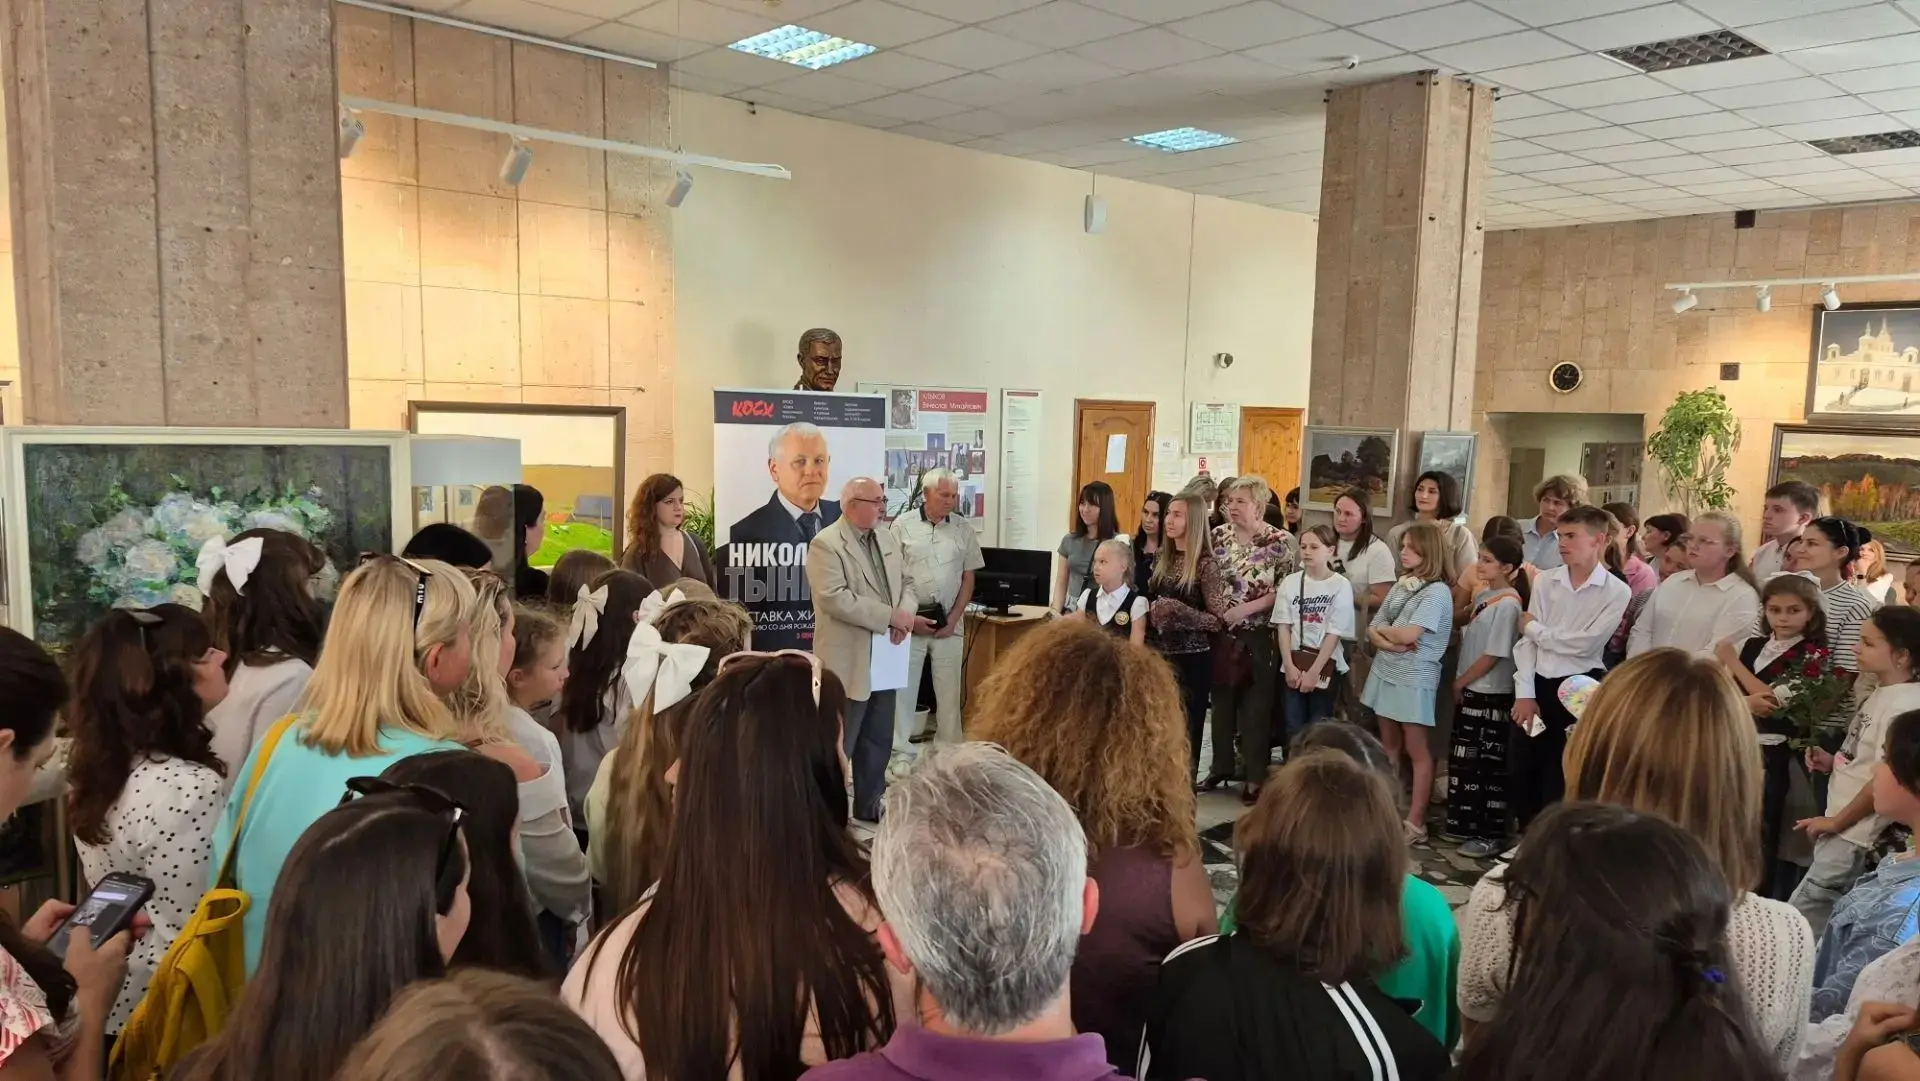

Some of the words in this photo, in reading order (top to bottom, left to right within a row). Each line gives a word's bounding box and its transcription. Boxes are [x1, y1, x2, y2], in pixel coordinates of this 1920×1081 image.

[1292, 594, 1336, 606] Beautiful
[1299, 605, 1326, 614] ision
[750, 610, 794, 622] ТАВКА
[768, 623, 779, 631] СО
